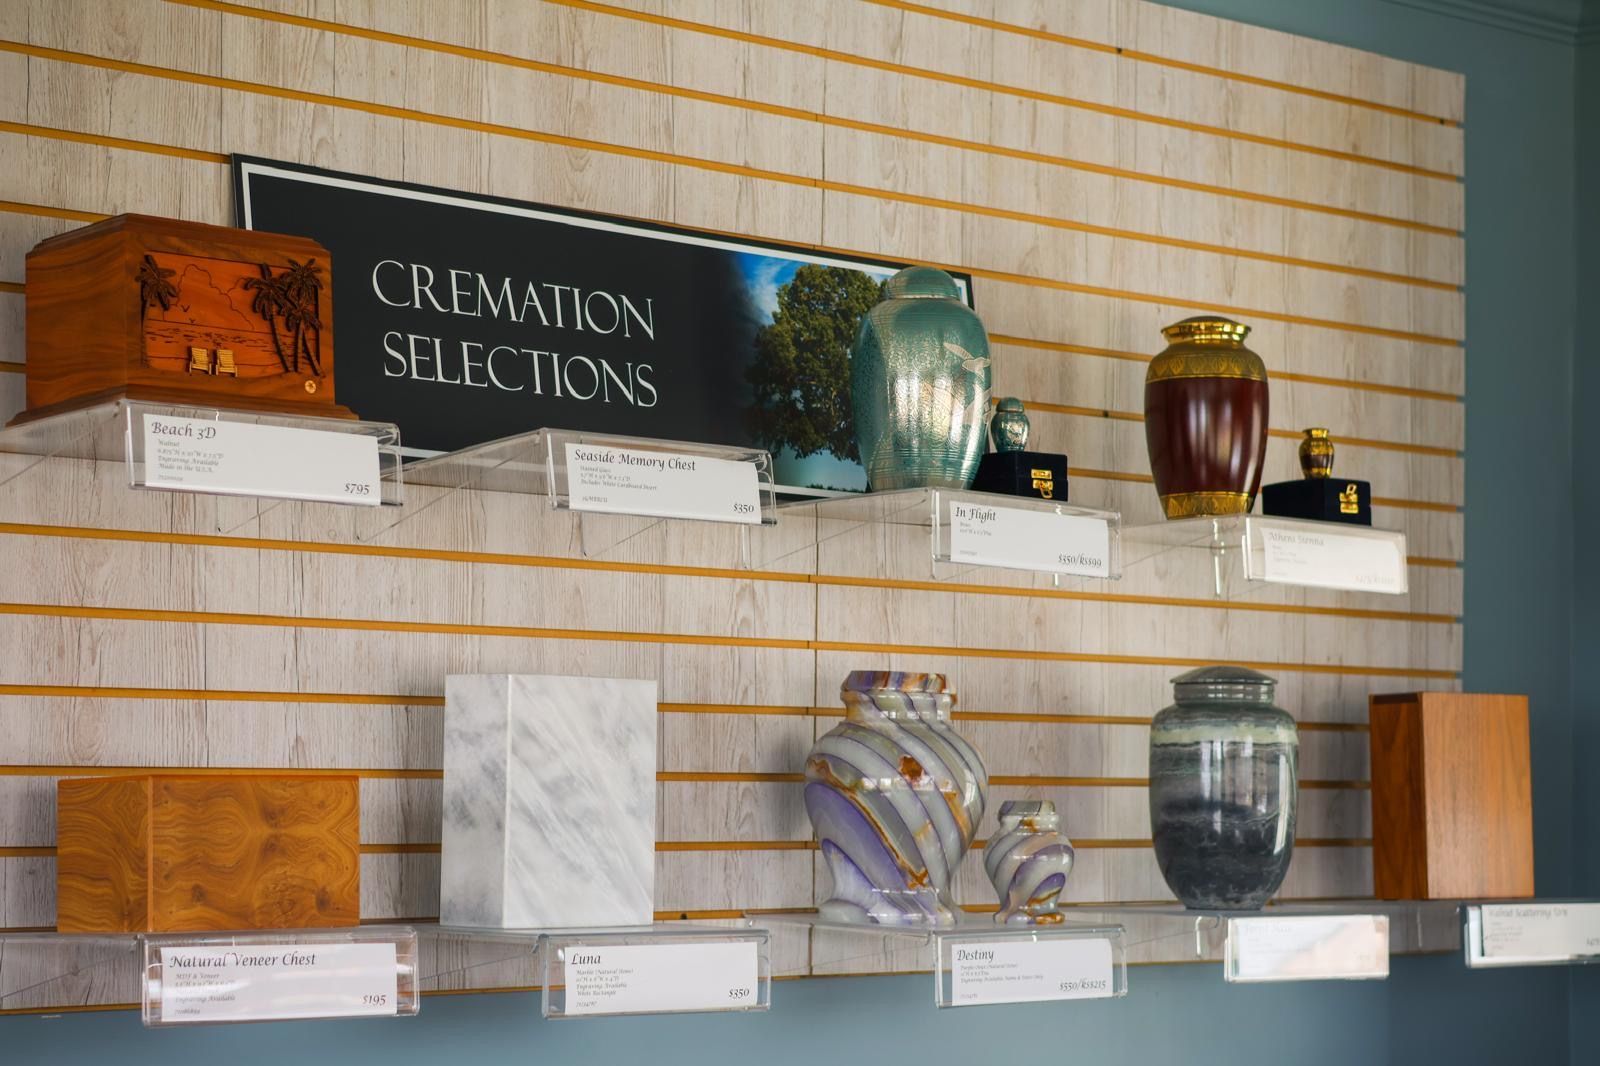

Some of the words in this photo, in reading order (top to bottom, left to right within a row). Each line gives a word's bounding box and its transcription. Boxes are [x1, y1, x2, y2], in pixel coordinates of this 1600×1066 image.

[372, 260, 654, 340] CREMATION
[383, 331, 658, 408] SELECTIONS
[151, 421, 193, 437] Beach
[197, 426, 217, 440] 3D
[574, 449, 615, 463] Seaside
[618, 453, 665, 471] Memory
[668, 457, 696, 471] Chest
[344, 483, 370, 496] $795
[733, 503, 754, 513] $350
[955, 507, 966, 517] In
[968, 508, 996, 523] Flight
[169, 952, 227, 968] Natural
[230, 952, 278, 967] Veneer
[282, 951, 316, 966] Chest
[571, 953, 601, 965] Luna
[956, 949, 994, 963] Destiny
[362, 995, 387, 1006] $195
[728, 988, 750, 999] $350
